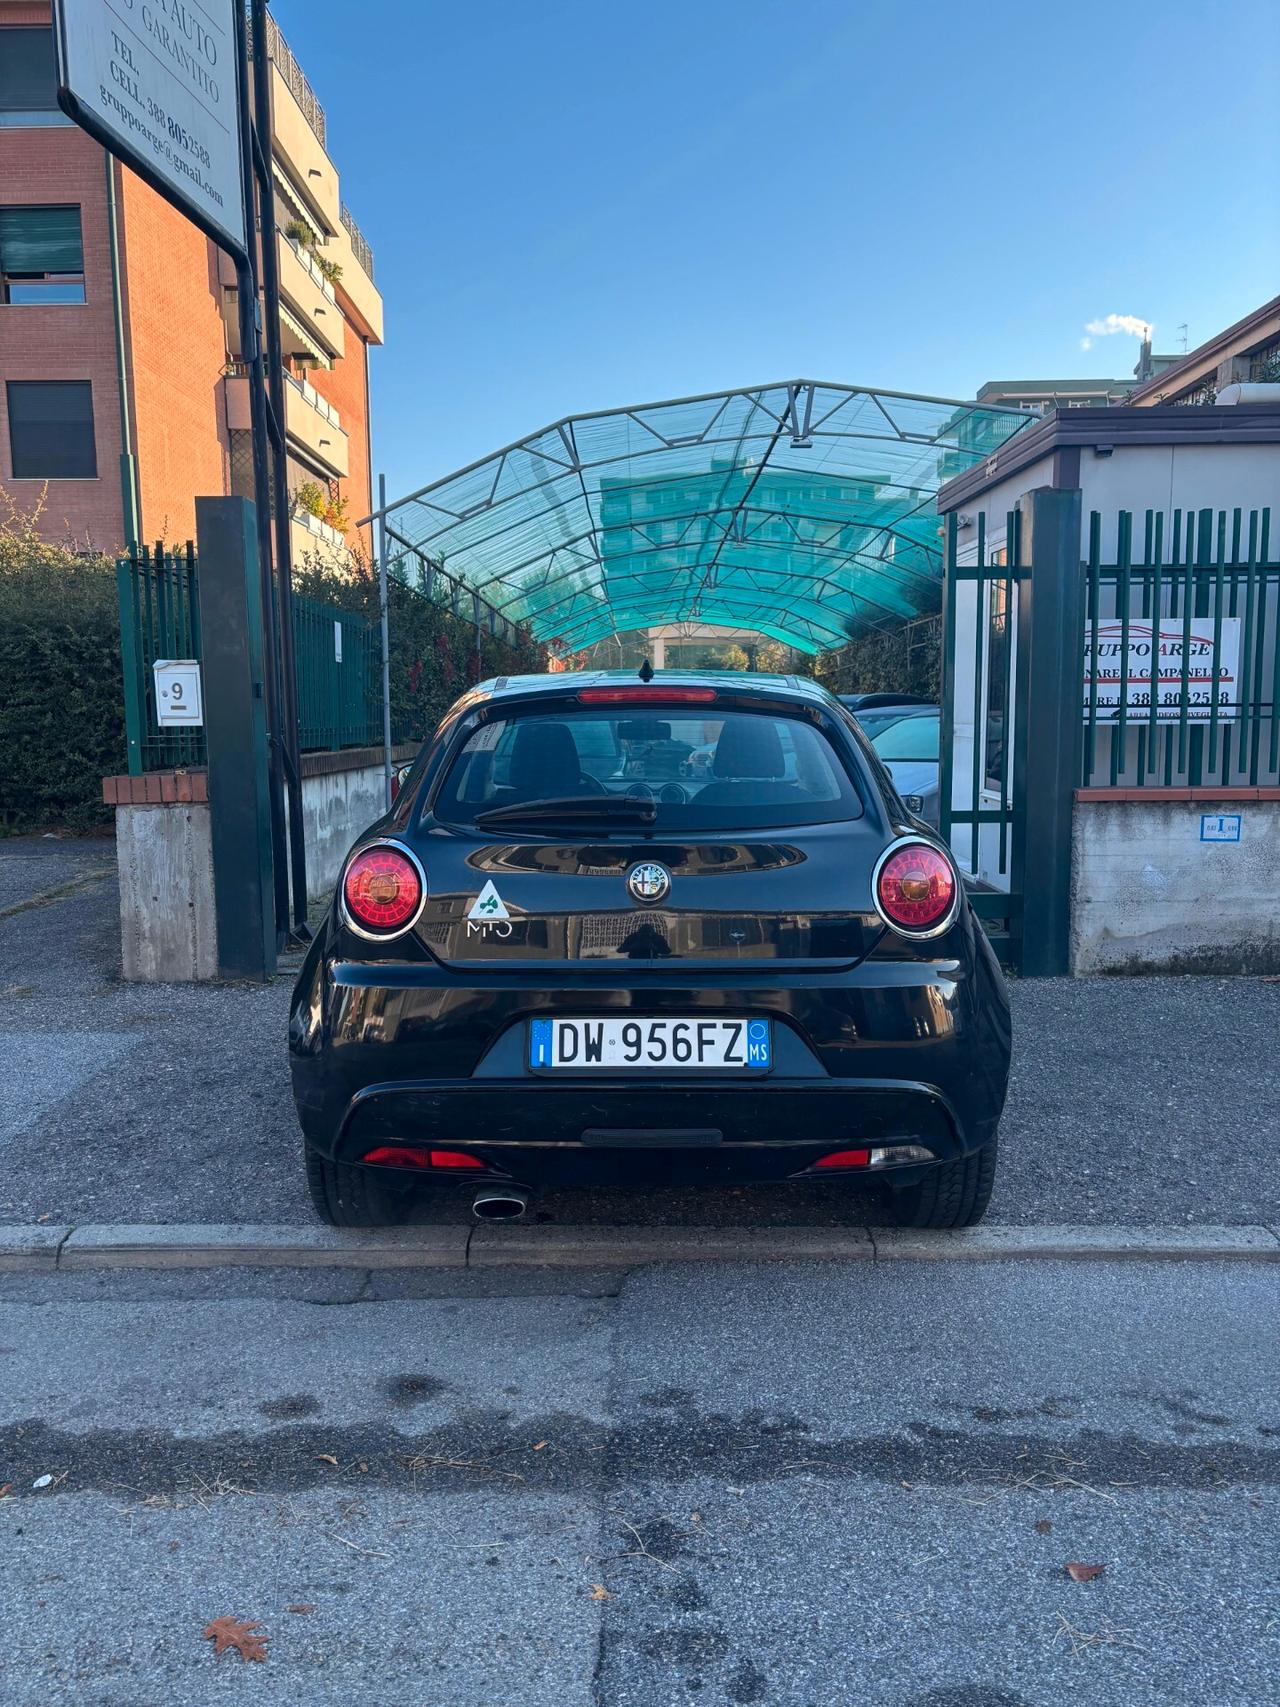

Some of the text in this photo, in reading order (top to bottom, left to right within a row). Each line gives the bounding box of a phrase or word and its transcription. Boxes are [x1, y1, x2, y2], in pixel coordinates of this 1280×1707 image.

[110, 29, 140, 76] TEL.
[142, 5, 219, 103] GARANTITO
[171, 0, 217, 66] AUTO
[110, 60, 211, 169] CELL. 388 8052588
[99, 84, 224, 208] gruppoarge@gmail.com
[171, 682, 184, 701] 9
[1164, 692, 1229, 704] 80258
[558, 1022, 744, 1063] DW 956FZ
[749, 1043, 768, 1062] MS
